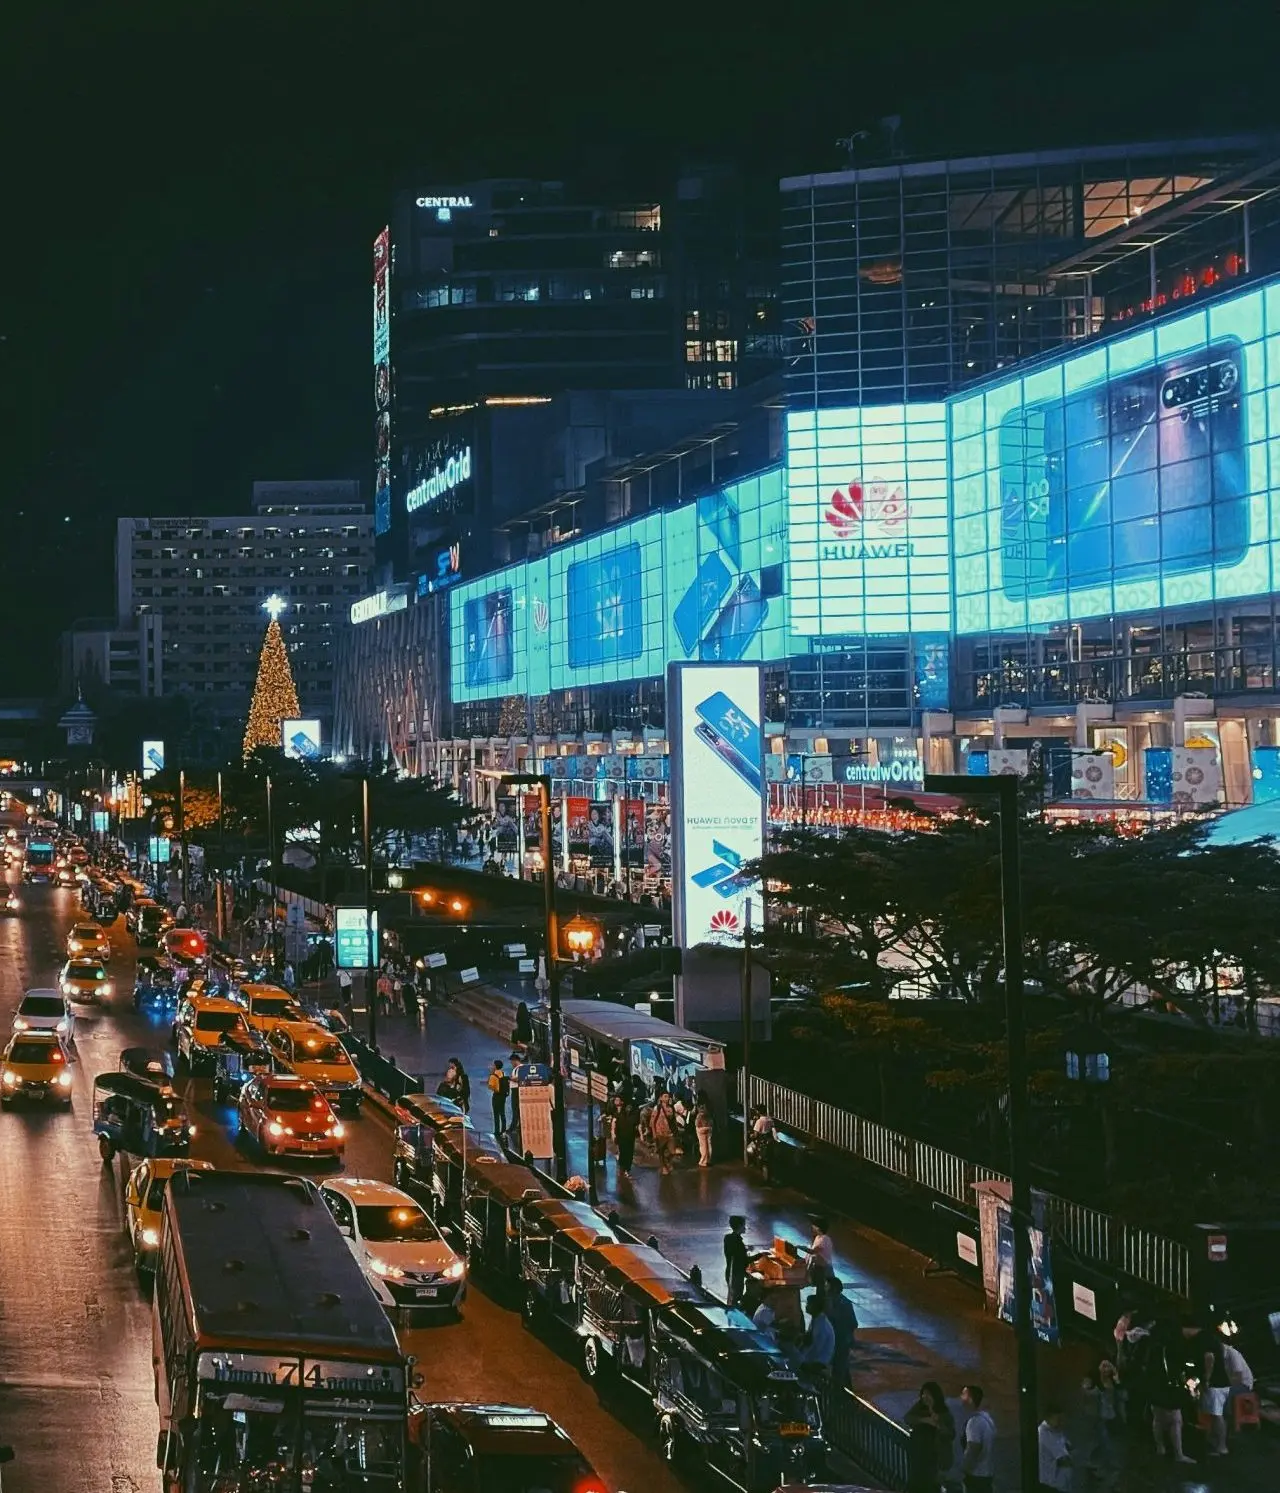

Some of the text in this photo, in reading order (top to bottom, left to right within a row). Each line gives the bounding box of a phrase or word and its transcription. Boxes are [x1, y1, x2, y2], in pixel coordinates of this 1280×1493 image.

[416, 196, 472, 207] CENTRAL
[824, 543, 915, 560] HUAWEI
[687, 817, 721, 825] HUAWEI
